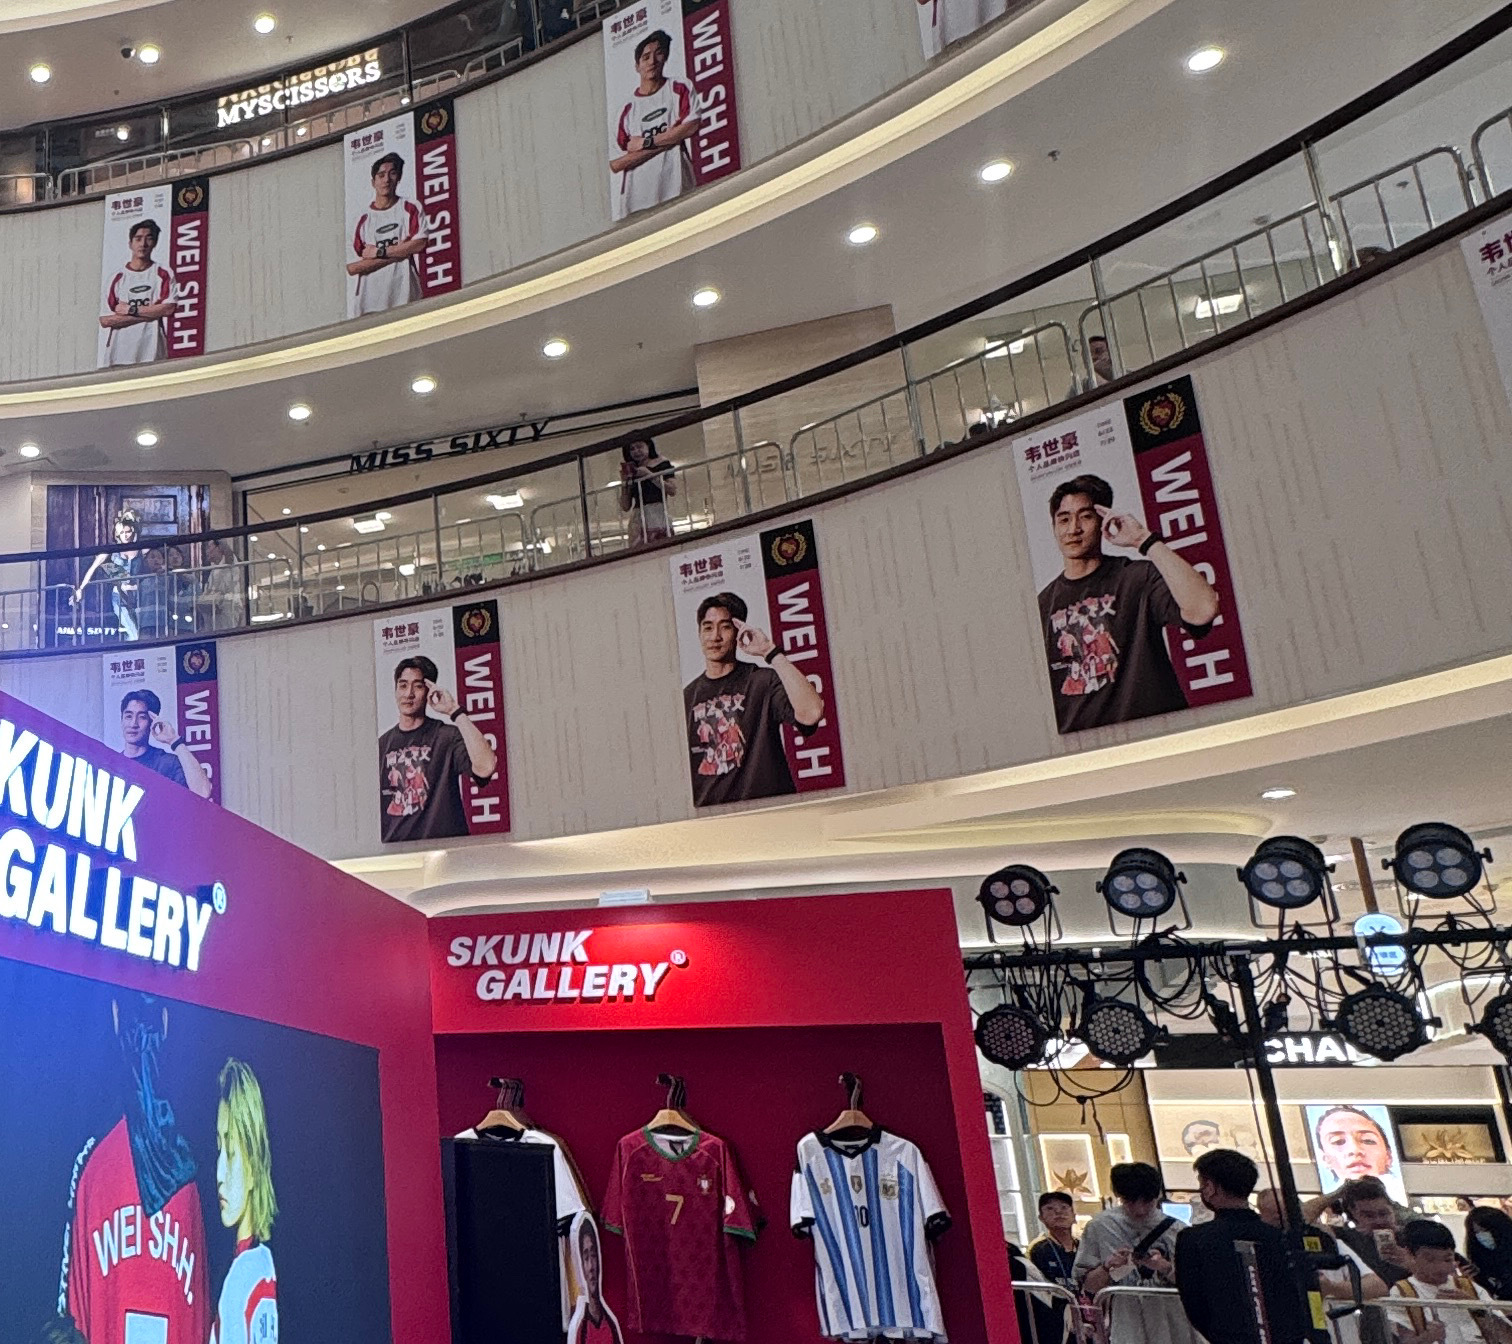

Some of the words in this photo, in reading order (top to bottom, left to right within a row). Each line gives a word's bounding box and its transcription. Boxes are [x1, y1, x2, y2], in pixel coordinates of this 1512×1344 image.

[692, 9, 723, 82] WEI
[423, 144, 449, 205] WEI
[176, 220, 200, 273] WEI
[350, 440, 434, 474] MISS
[449, 418, 550, 456] SIXTY
[1151, 451, 1208, 550] WEI
[778, 581, 818, 662] WEI
[464, 653, 496, 722] WEI
[184, 689, 212, 752] WEI
[447, 930, 593, 967] SKUNK
[93, 1205, 142, 1277] WEI
[665, 1194, 684, 1225] 7
